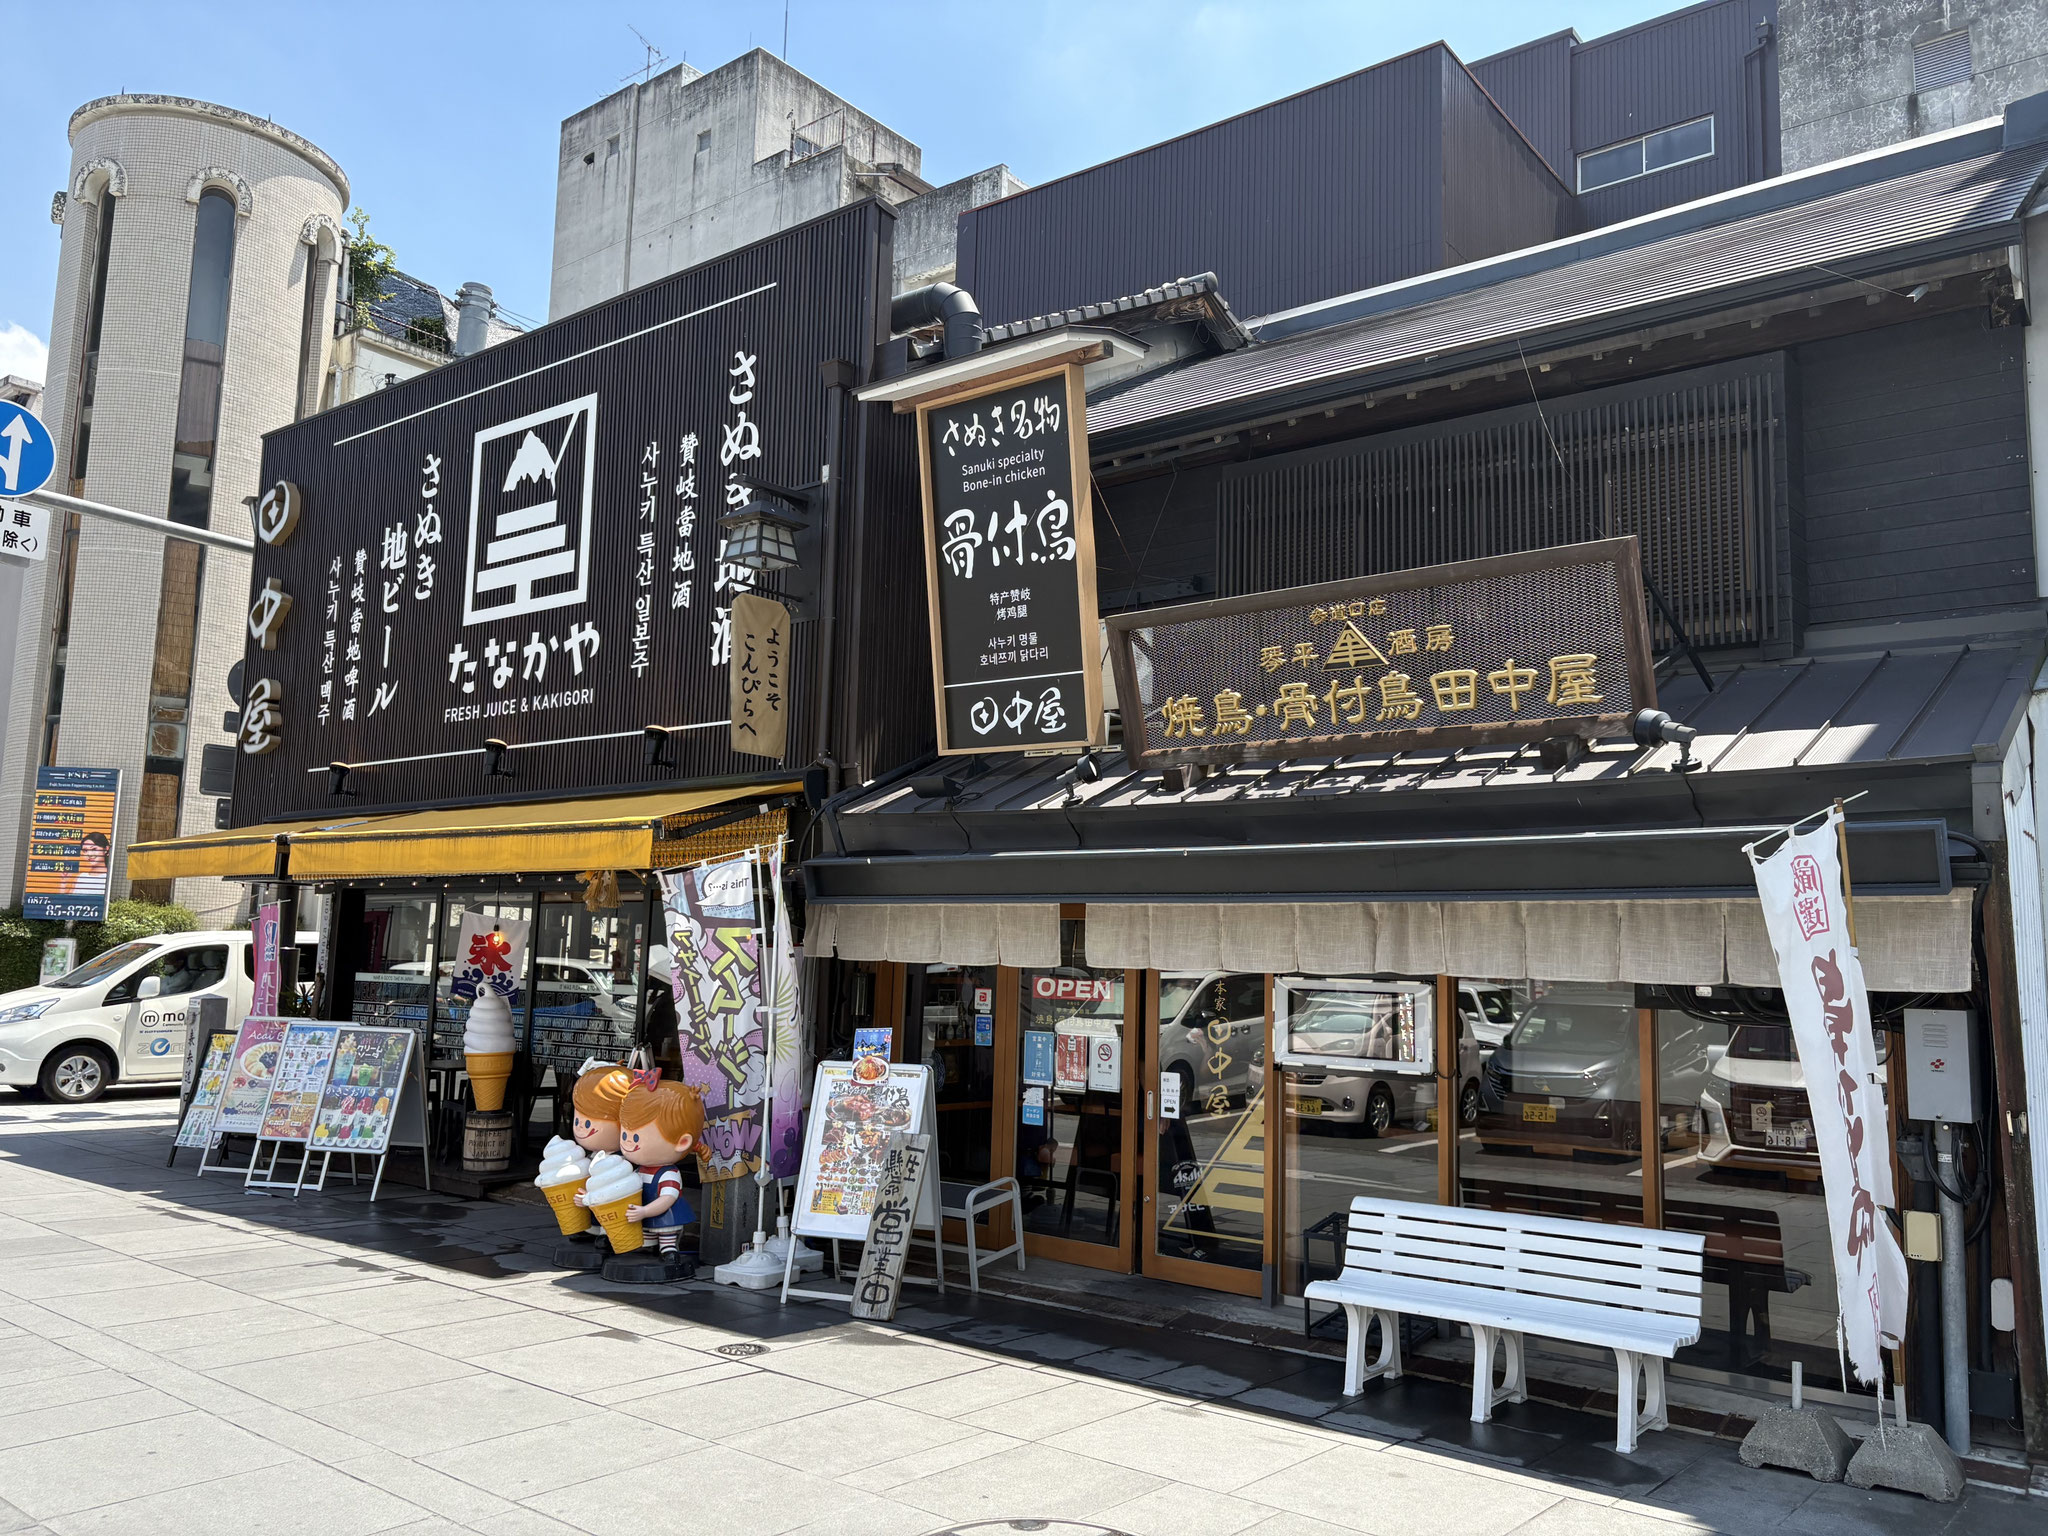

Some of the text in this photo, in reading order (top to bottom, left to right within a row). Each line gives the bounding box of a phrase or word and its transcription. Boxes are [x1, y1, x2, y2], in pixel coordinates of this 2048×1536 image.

[943, 395, 1060, 457] さぬき名物
[961, 448, 1045, 476] Sanuki specialty
[963, 466, 1046, 493] Bone-in chicken
[414, 453, 442, 600] さぬき
[942, 489, 1076, 579] 骨付鳥
[630, 441, 660, 678] 사누키 특산 일본주
[317, 556, 342, 726] 사누키 특산 맥주
[367, 521, 408, 718] 地ビール
[988, 632, 1038, 650] 사누키 명물
[448, 621, 600, 694] たなかや
[765, 628, 782, 711] ようこそ
[1019, 646, 1049, 662] 닭다리
[1259, 624, 1455, 673] 琴平 酒房
[444, 688, 594, 723] FRESH JUICE & KAKIGORI
[739, 633, 762, 736] こんぴらへ
[970, 687, 1067, 735] 田中屋
[46, 905, 99, 917] 85-8726
[467, 932, 513, 976] 氷
[1036, 977, 1111, 1000] OPEN
[247, 1029, 275, 1040] Acai
[357, 1044, 383, 1053] クリーム
[1205, 1016, 1232, 1118] 田中屋
[881, 1149, 904, 1196] 懸命
[903, 1144, 926, 1183] 一生
[860, 1196, 911, 1313] 営業中
